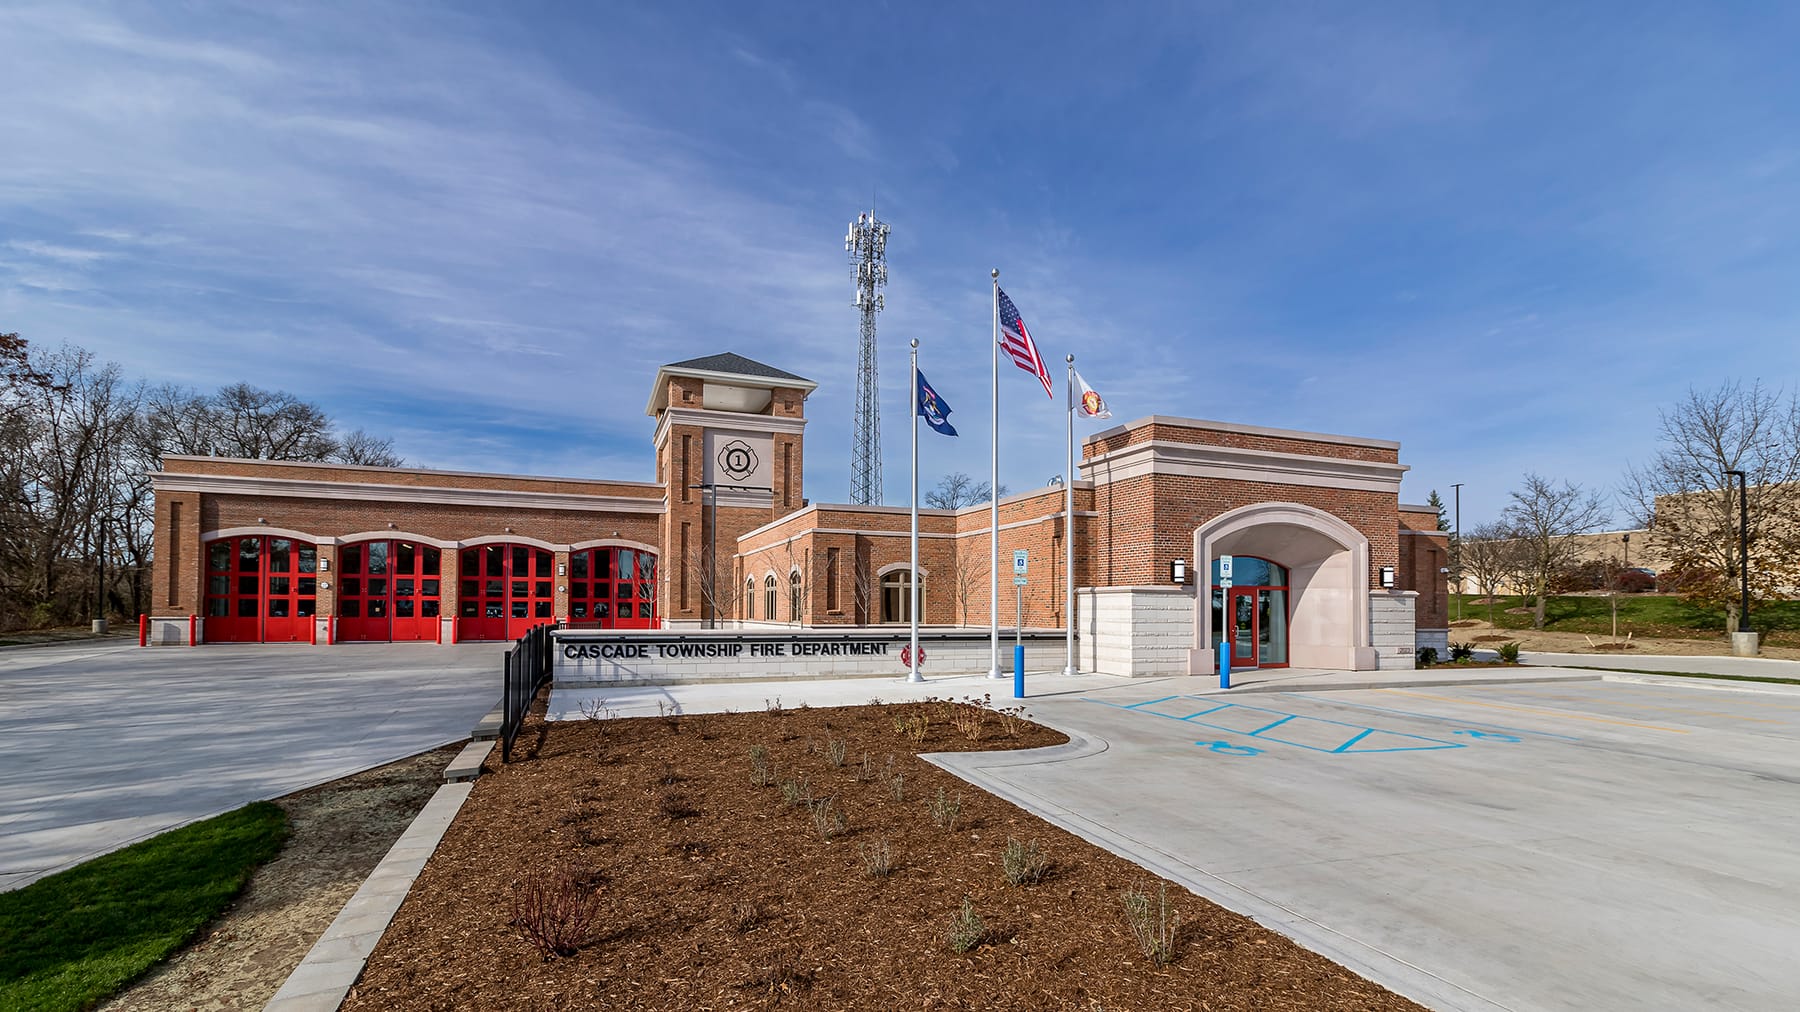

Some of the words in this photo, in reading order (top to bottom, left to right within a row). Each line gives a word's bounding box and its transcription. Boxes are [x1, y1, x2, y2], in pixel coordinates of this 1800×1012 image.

[735, 455, 742, 466] 1
[564, 644, 649, 658] CASCADE
[656, 643, 743, 658] TOWNSHIP
[750, 643, 785, 657] FIRE
[792, 642, 888, 656] DEPARTMENT
